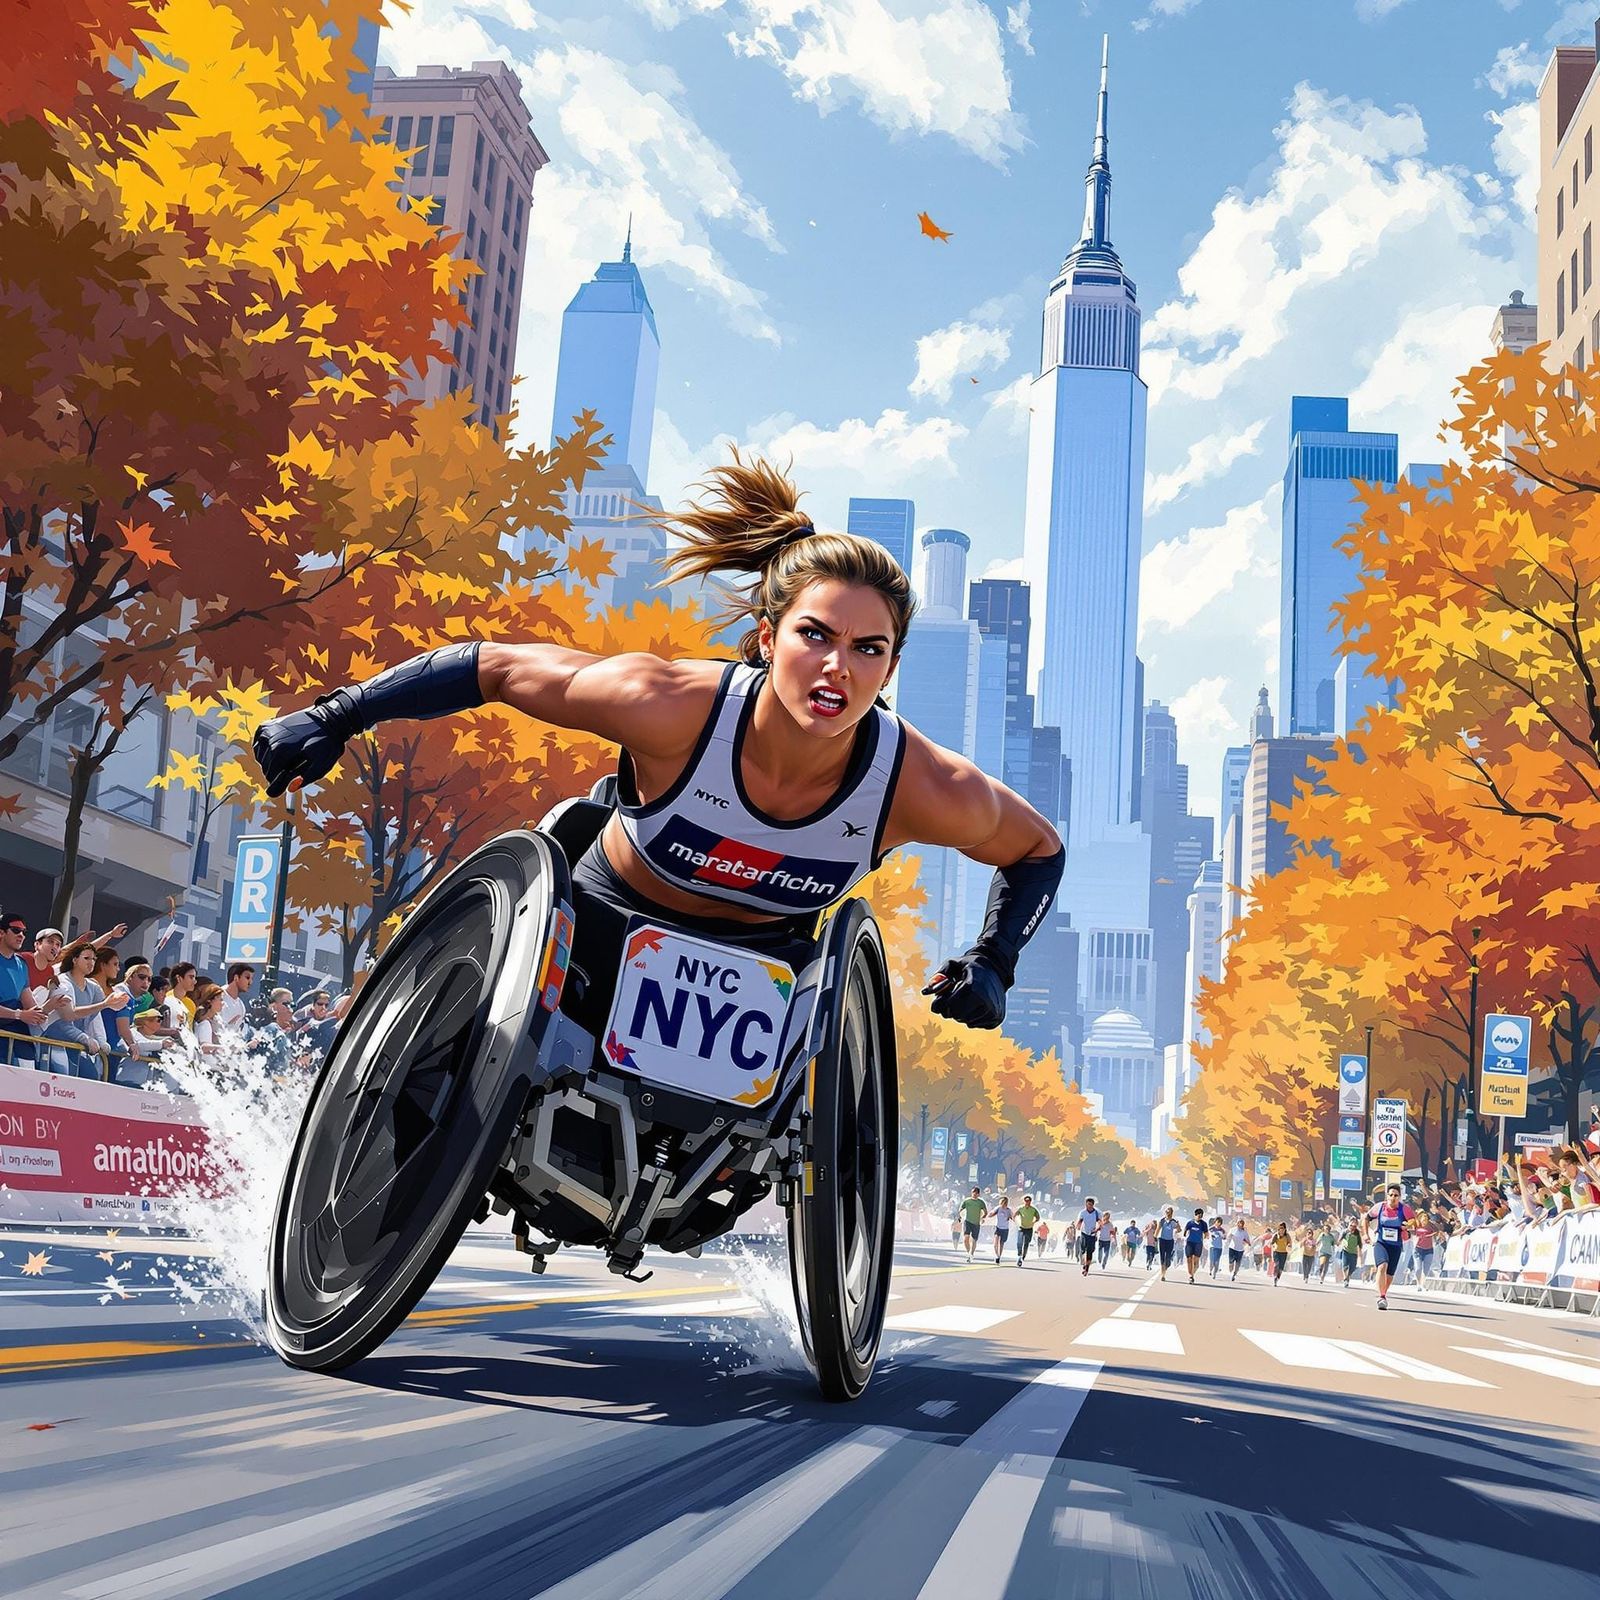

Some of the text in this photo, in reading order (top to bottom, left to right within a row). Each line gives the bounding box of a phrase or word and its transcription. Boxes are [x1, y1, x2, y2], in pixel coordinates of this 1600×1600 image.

[693, 788, 730, 809] NYYC
[674, 954, 741, 994] NYC
[628, 976, 773, 1071] NYC
[0, 1113, 24, 1137] ON
[93, 1138, 200, 1178] amathon
